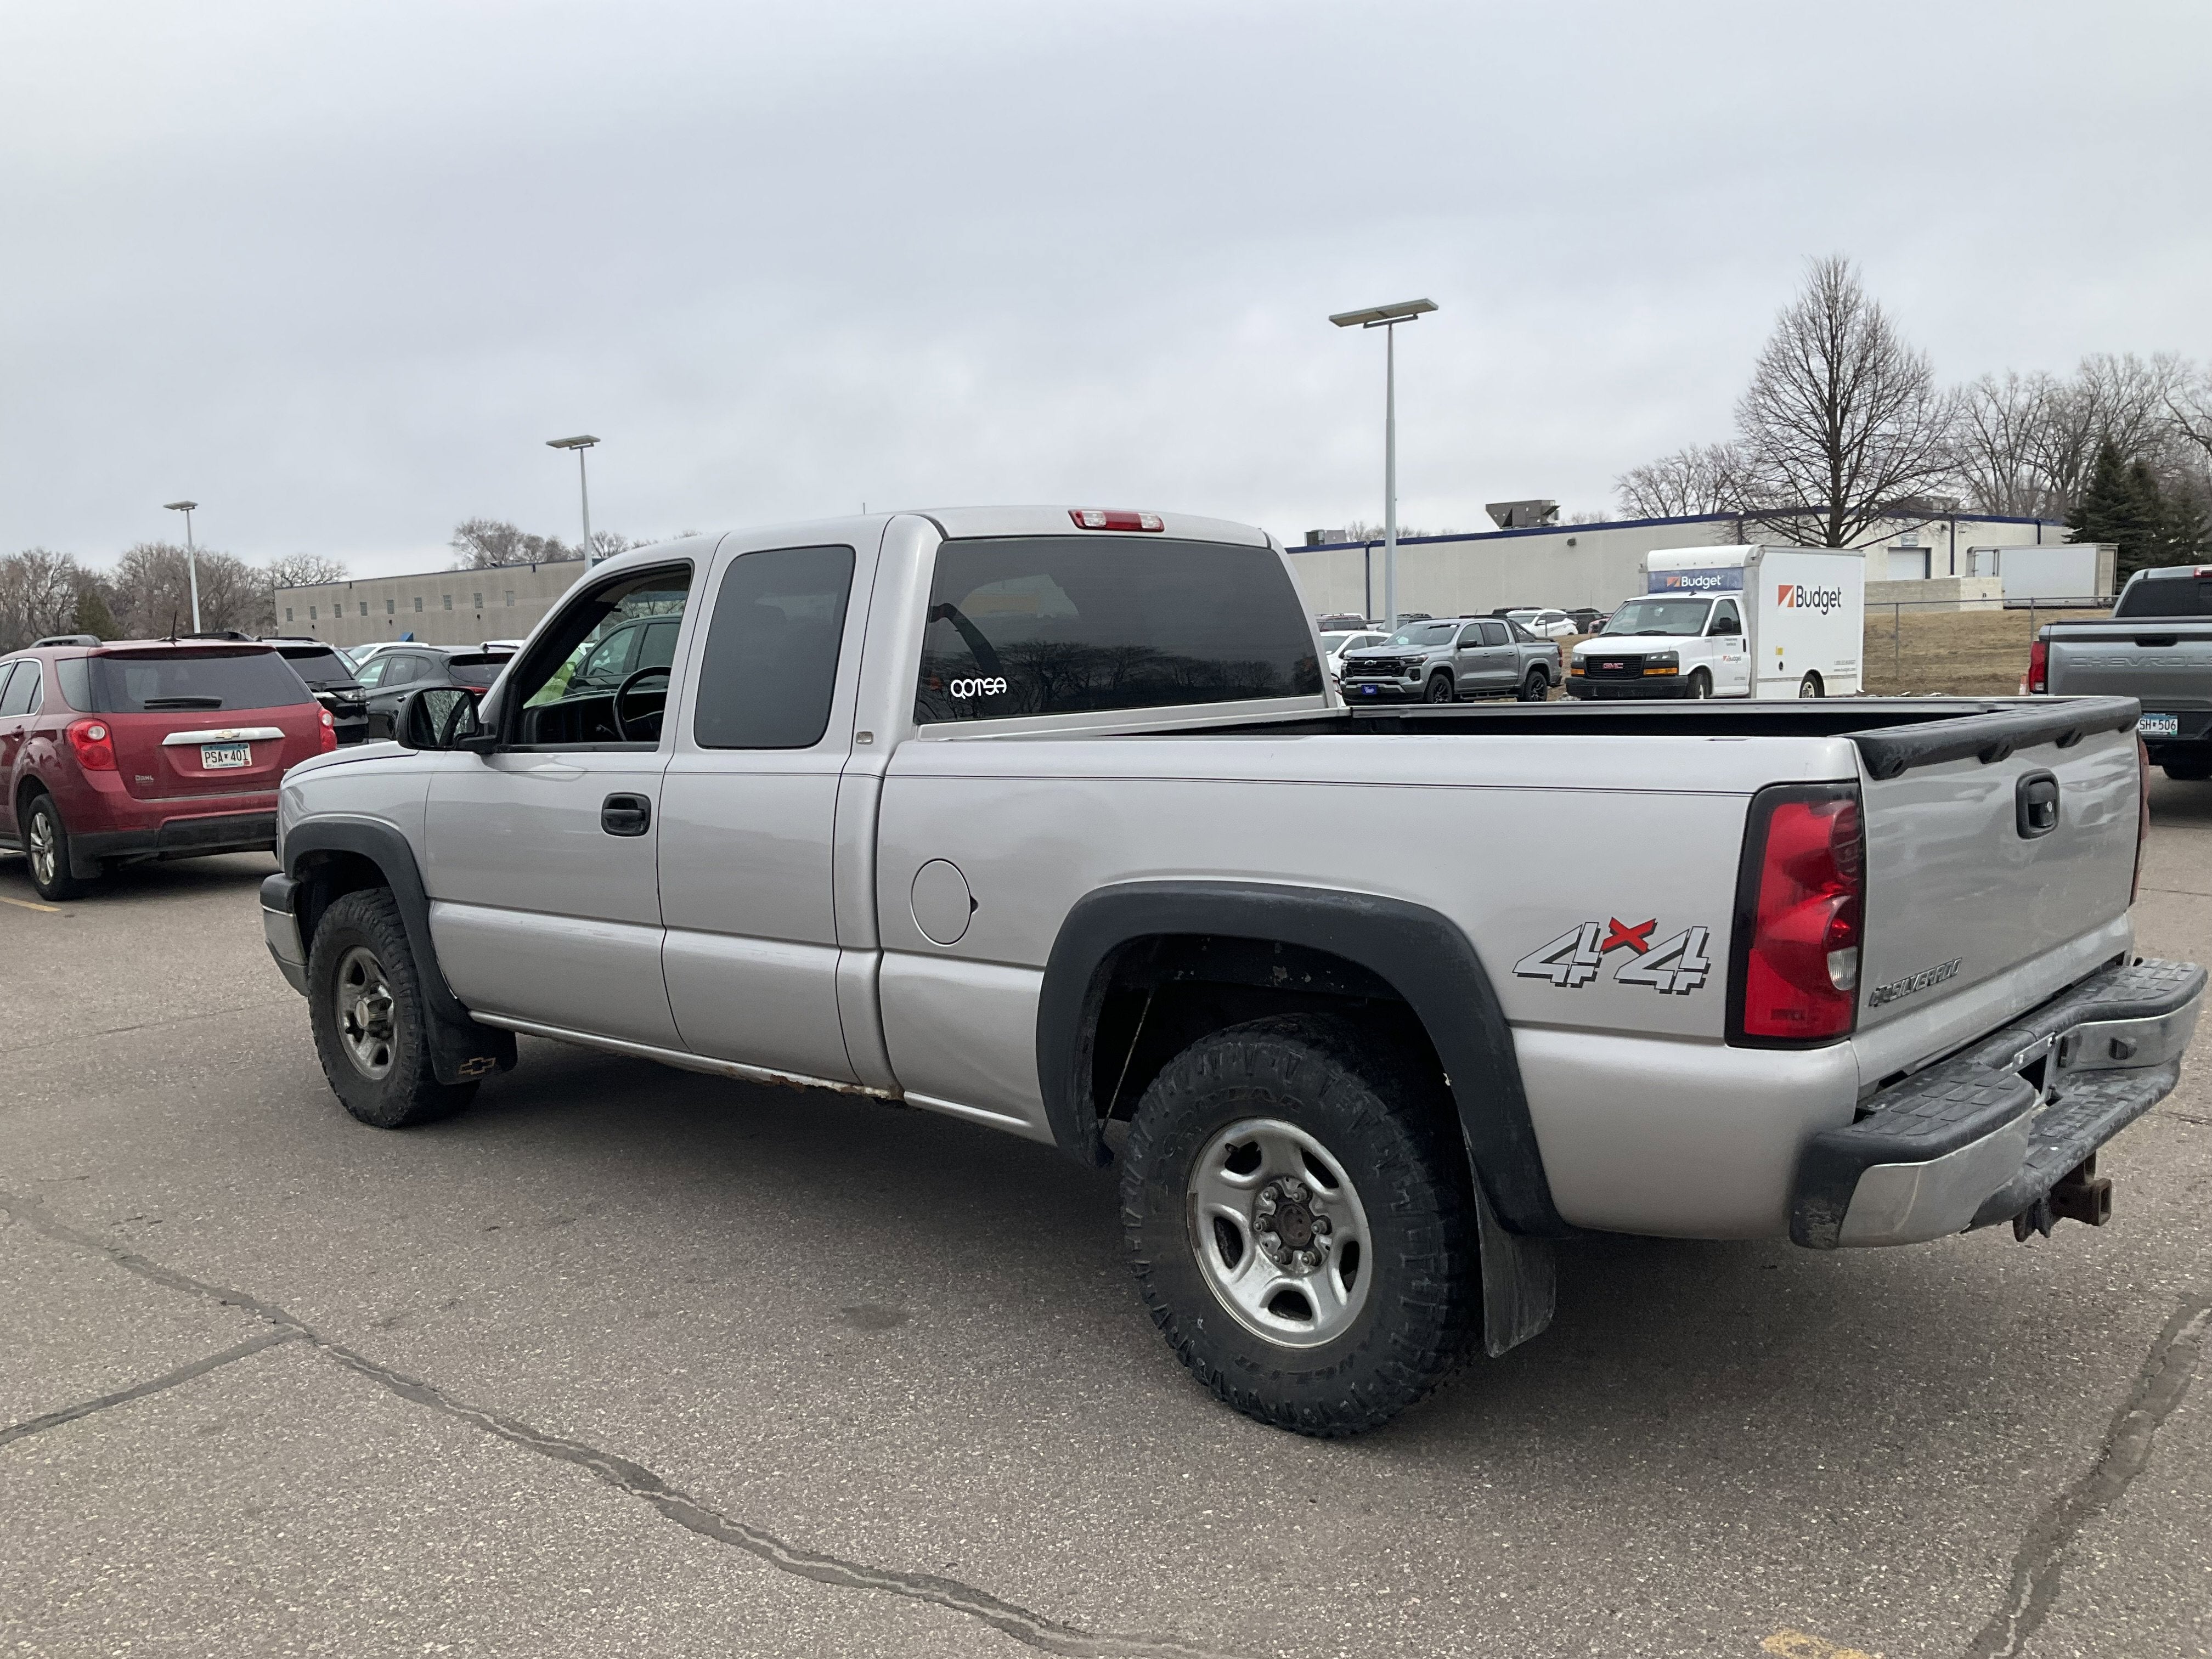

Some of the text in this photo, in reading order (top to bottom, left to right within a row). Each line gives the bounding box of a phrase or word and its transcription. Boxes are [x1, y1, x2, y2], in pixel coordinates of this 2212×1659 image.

[1681, 575, 1722, 590] Budget
[1796, 585, 1842, 616] Budget
[950, 677, 1007, 699] QOTSA
[2140, 719, 2176, 730] SH 506
[205, 749, 249, 763] PSA 401
[1890, 957, 1963, 1001] SILVERADO
